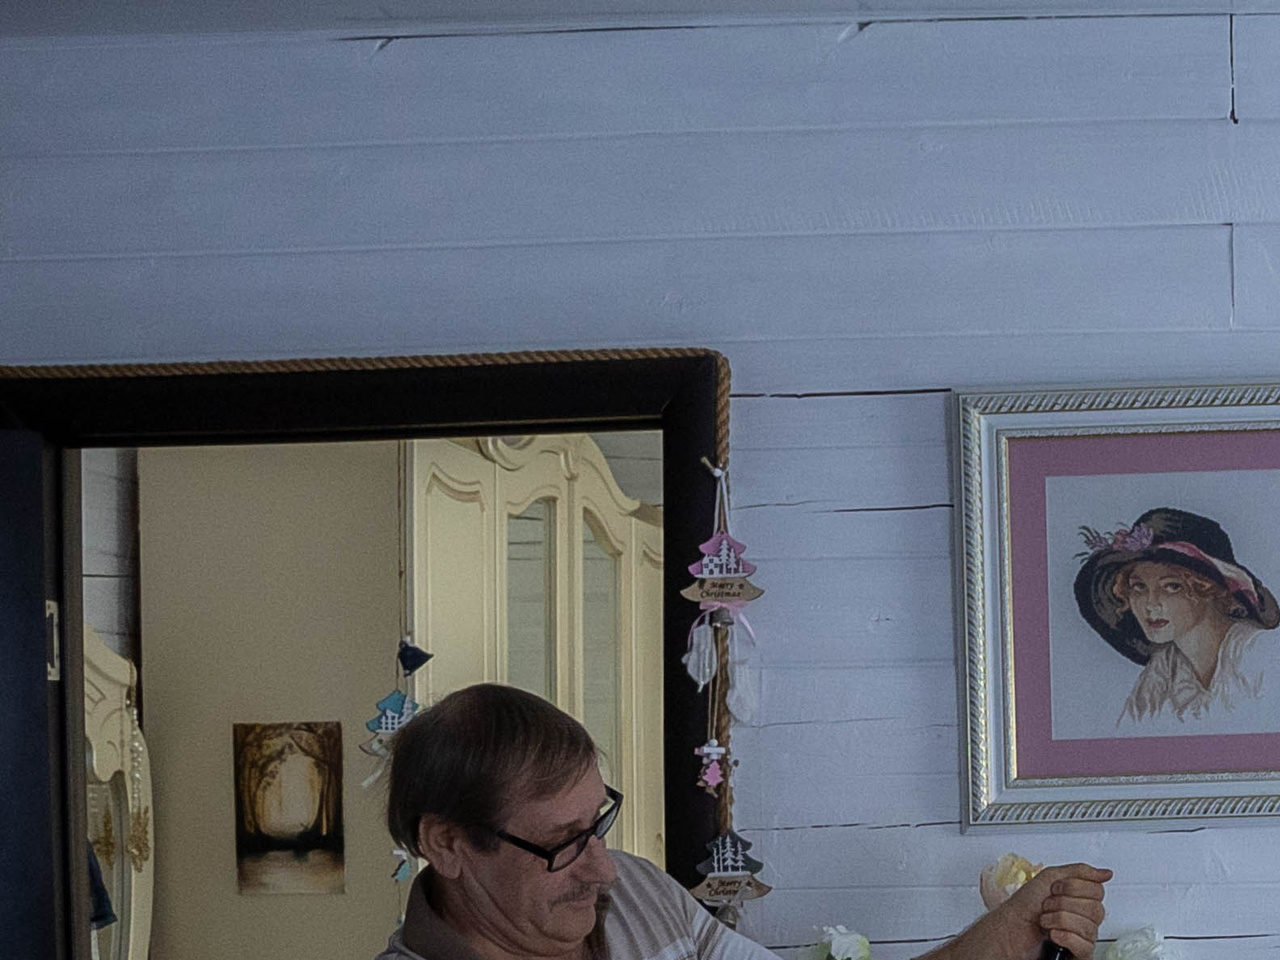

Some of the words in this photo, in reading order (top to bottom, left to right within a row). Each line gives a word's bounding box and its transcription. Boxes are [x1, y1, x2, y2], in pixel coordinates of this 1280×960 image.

[710, 581, 735, 590] Merry
[700, 590, 742, 599] Christmas
[718, 880, 742, 889] Merry
